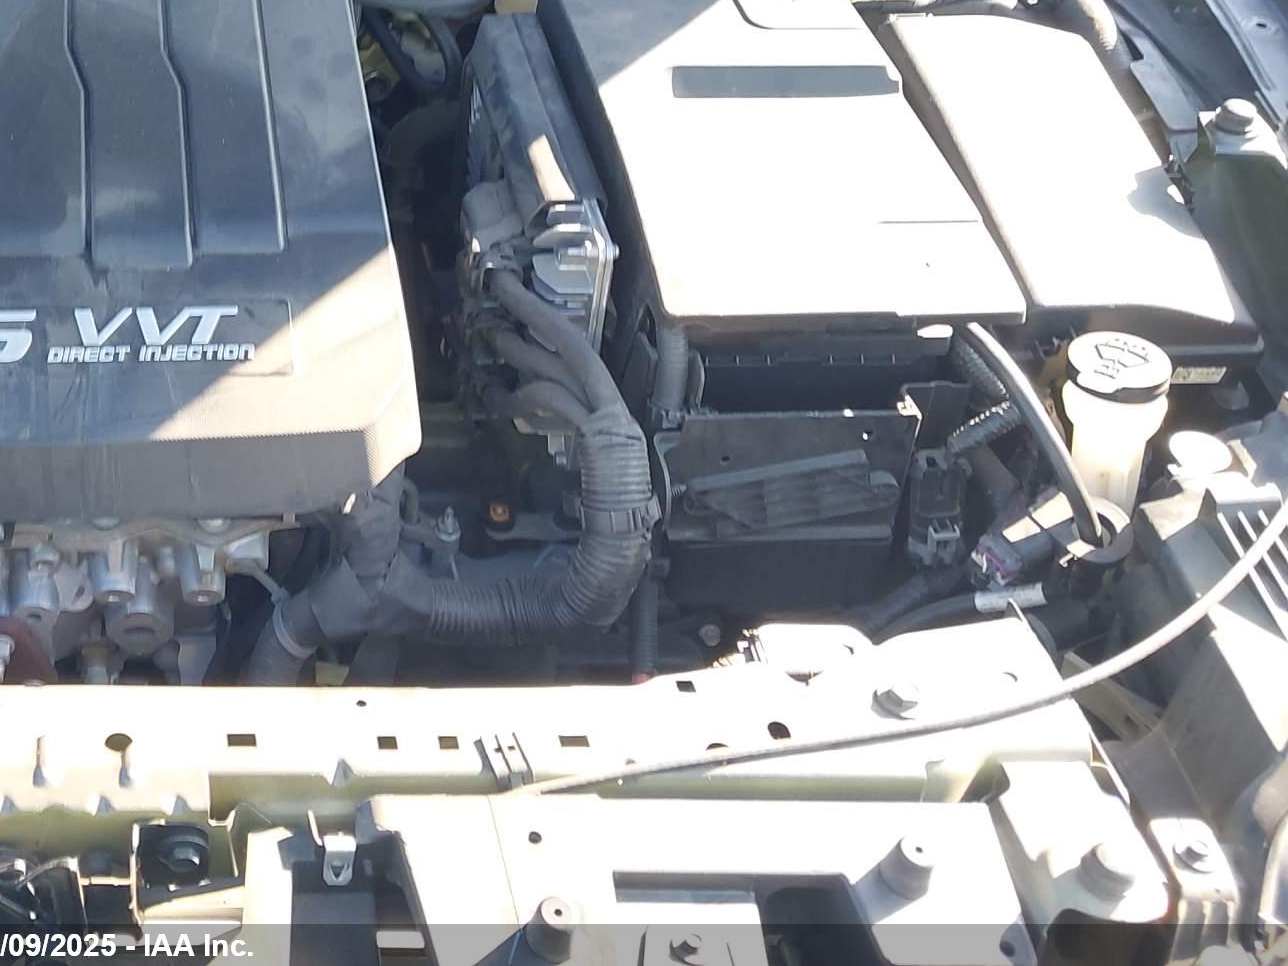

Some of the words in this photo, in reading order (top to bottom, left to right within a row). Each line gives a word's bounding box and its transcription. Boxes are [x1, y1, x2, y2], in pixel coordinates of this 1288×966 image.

[73, 305, 239, 344] VVT
[47, 345, 131, 364] DIRECT
[139, 342, 255, 363] INJECTION
